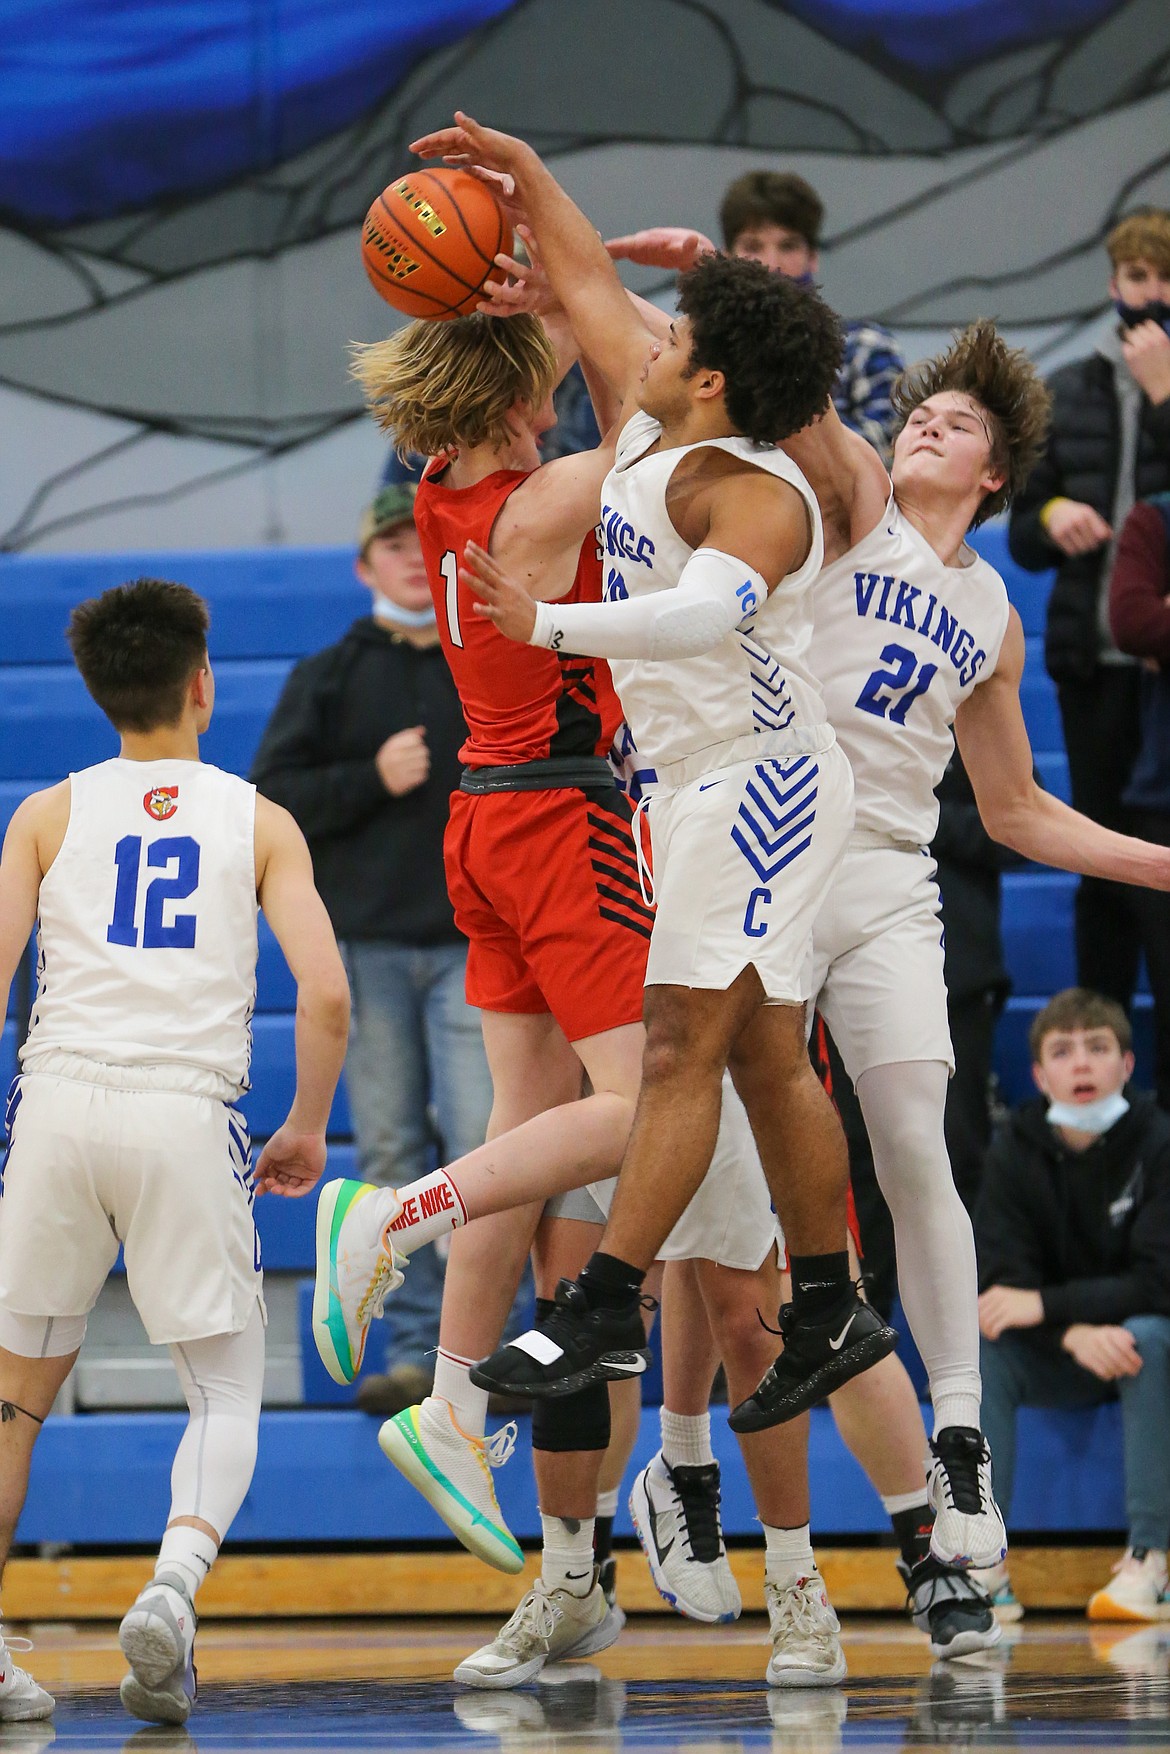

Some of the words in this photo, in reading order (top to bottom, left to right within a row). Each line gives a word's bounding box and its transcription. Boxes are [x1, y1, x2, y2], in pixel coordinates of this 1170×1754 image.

[439, 549, 464, 650] 1
[735, 579, 758, 623] IC
[854, 572, 987, 688] VIKINGS
[855, 643, 938, 726] 21
[107, 834, 201, 948] 12
[743, 887, 772, 937] C
[418, 1182, 455, 1220] NIKE
